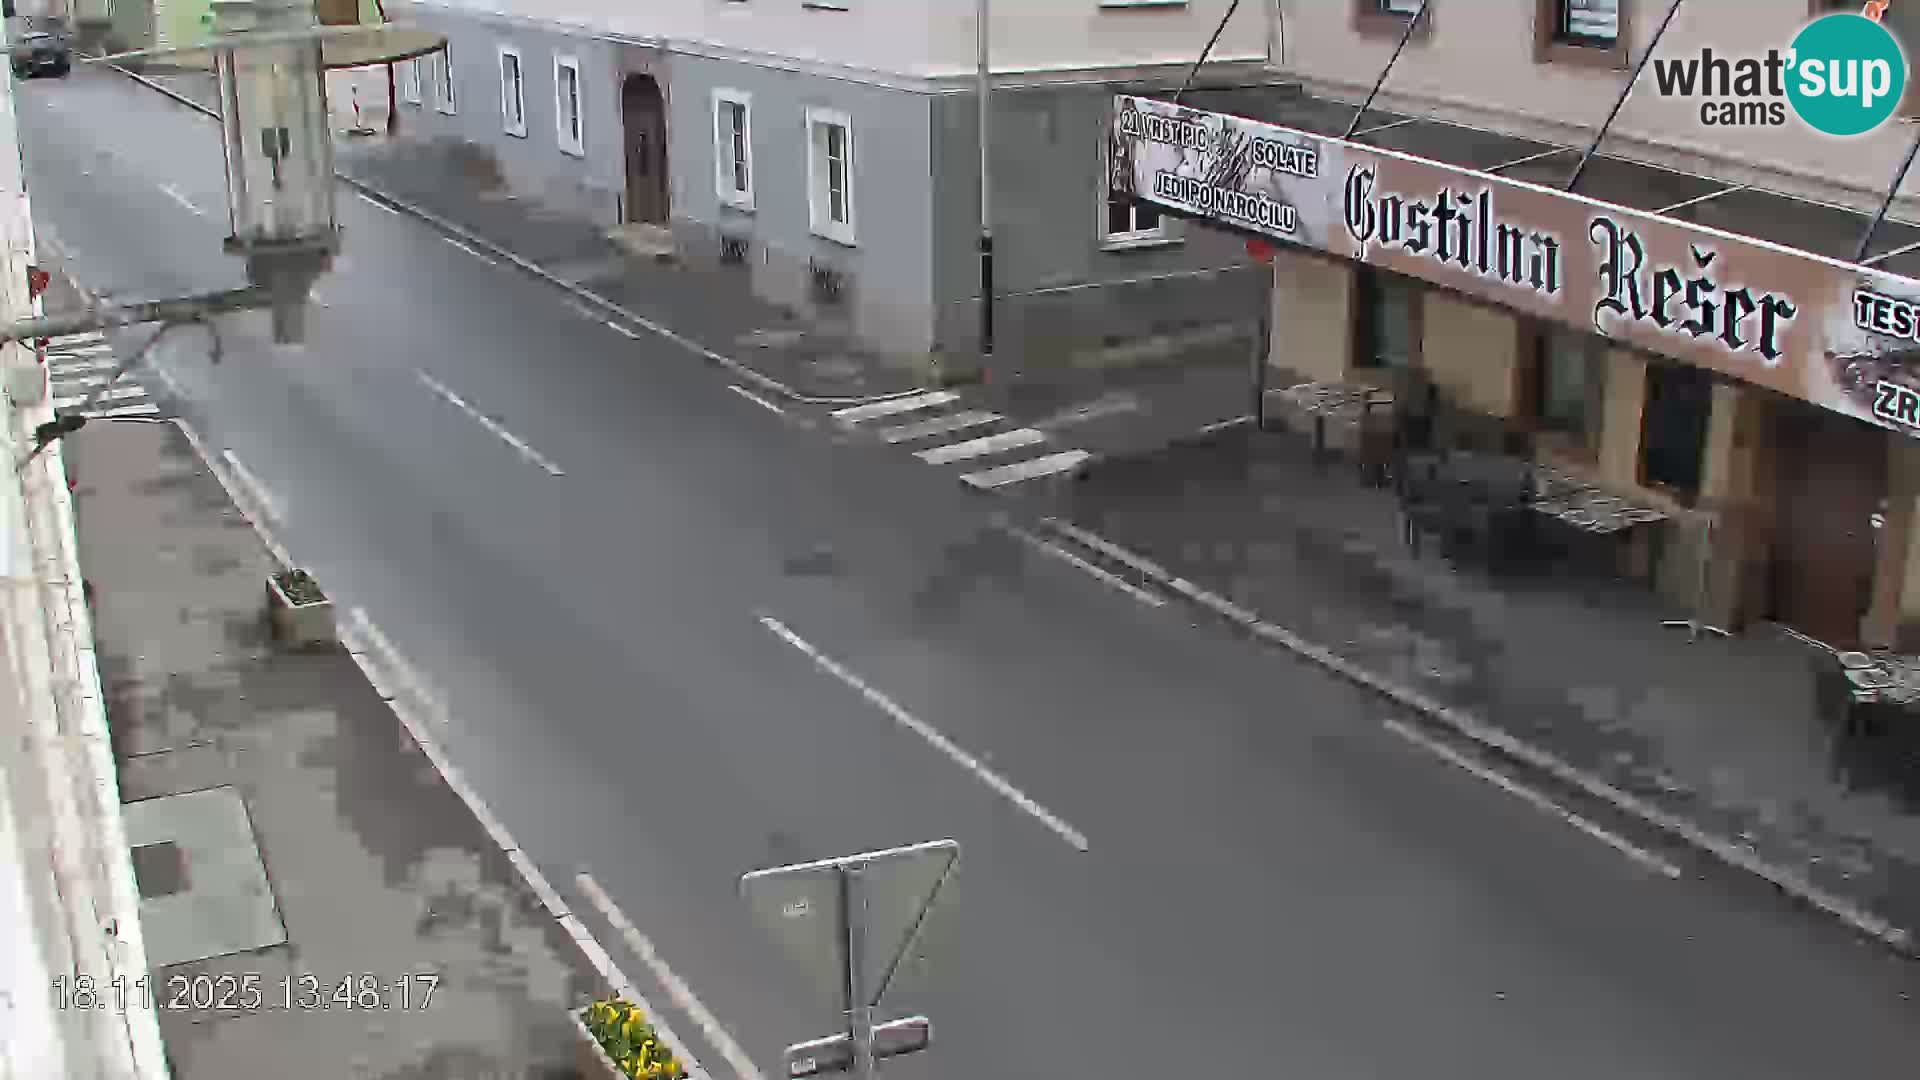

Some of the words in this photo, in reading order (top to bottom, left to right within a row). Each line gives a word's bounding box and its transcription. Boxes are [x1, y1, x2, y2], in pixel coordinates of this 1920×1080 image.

[1252, 136, 1317, 177] SOLATE
[1214, 186, 1296, 232] NAROČILU
[1344, 162, 1561, 295] Gostilna
[1589, 216, 1798, 361] Rešer
